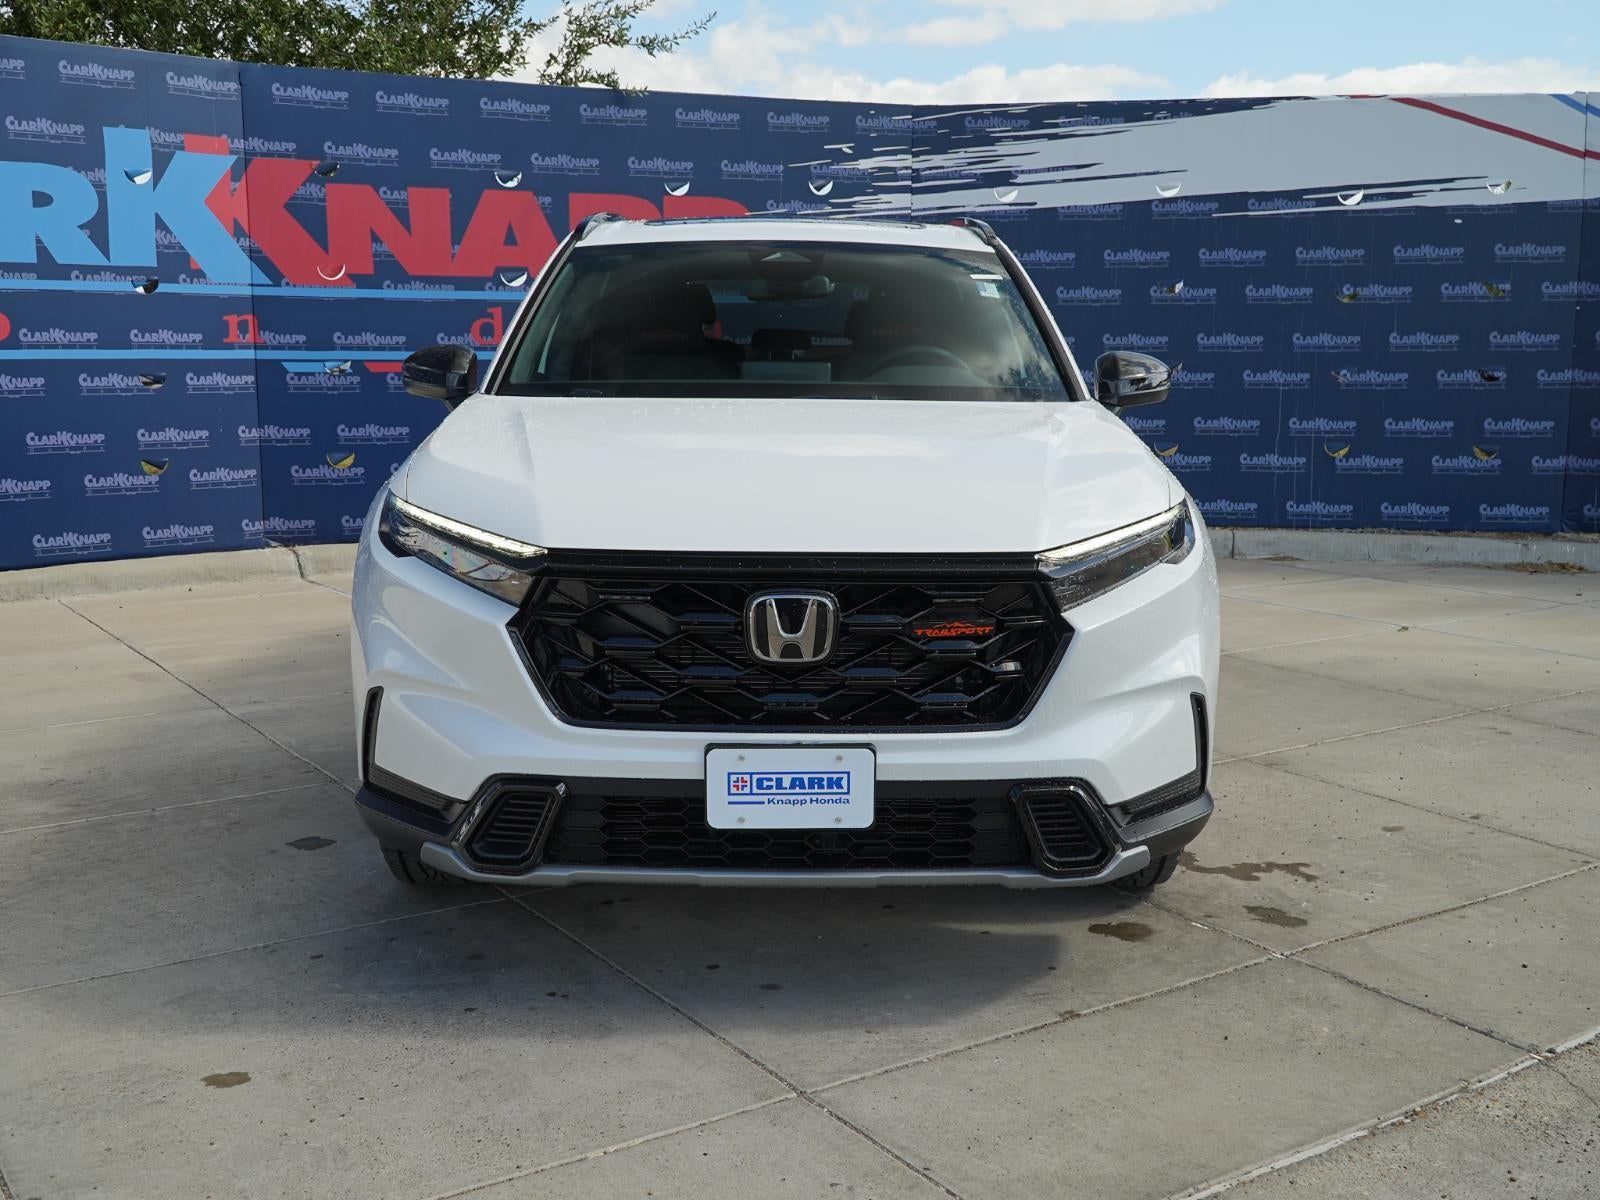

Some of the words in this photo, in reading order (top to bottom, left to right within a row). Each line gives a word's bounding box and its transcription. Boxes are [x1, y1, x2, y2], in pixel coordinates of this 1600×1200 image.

[756, 777, 844, 790] CLARK
[767, 797, 806, 806] Knapp
[809, 797, 850, 805] Honda
